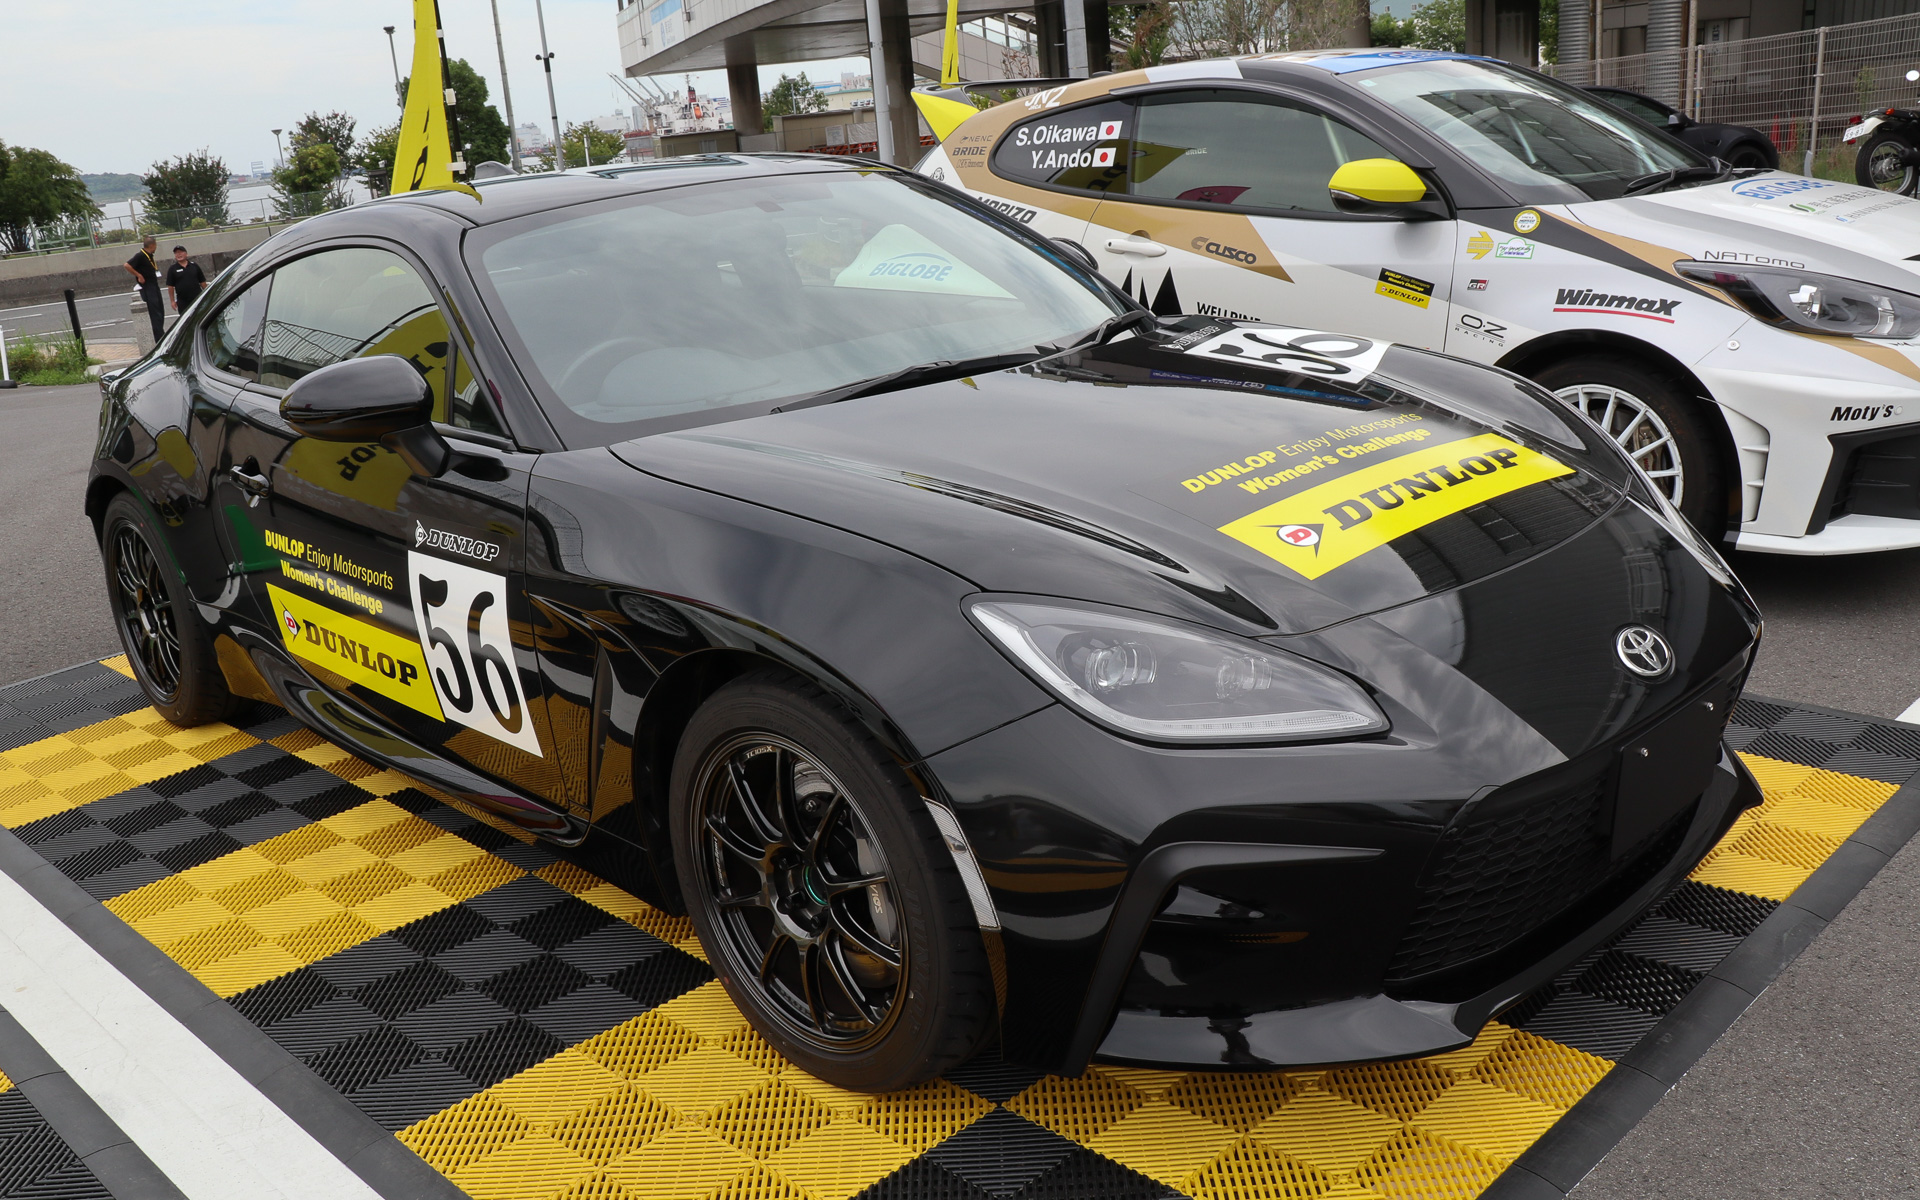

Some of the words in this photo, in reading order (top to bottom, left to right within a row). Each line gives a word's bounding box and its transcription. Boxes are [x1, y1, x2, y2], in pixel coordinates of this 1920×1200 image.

[952, 146, 987, 156] BRIDE
[1015, 124, 1098, 147] S.Oikawa
[1031, 148, 1092, 169] Y.Ando
[868, 262, 953, 282] BIGLOBE
[1387, 288, 1425, 303] DUNLOP
[1454, 327, 1504, 348] RACING
[1829, 403, 1894, 422] Moty's
[1181, 449, 1278, 494] DUNLOP
[1278, 431, 1332, 457] Enjoy
[1326, 411, 1423, 441] Motorsports
[1237, 454, 1339, 496] Women's
[1335, 426, 1432, 461] Challenge
[1321, 446, 1519, 532] DUNLOP
[264, 530, 305, 559] DUNLOP
[306, 543, 331, 572] Enjoy
[333, 552, 394, 591] Motorsports
[426, 529, 500, 562] DUNLOP
[281, 560, 325, 593] Women's
[327, 578, 383, 615] Challenge
[303, 618, 418, 687] DUNLOP
[418, 573, 523, 735] 56
